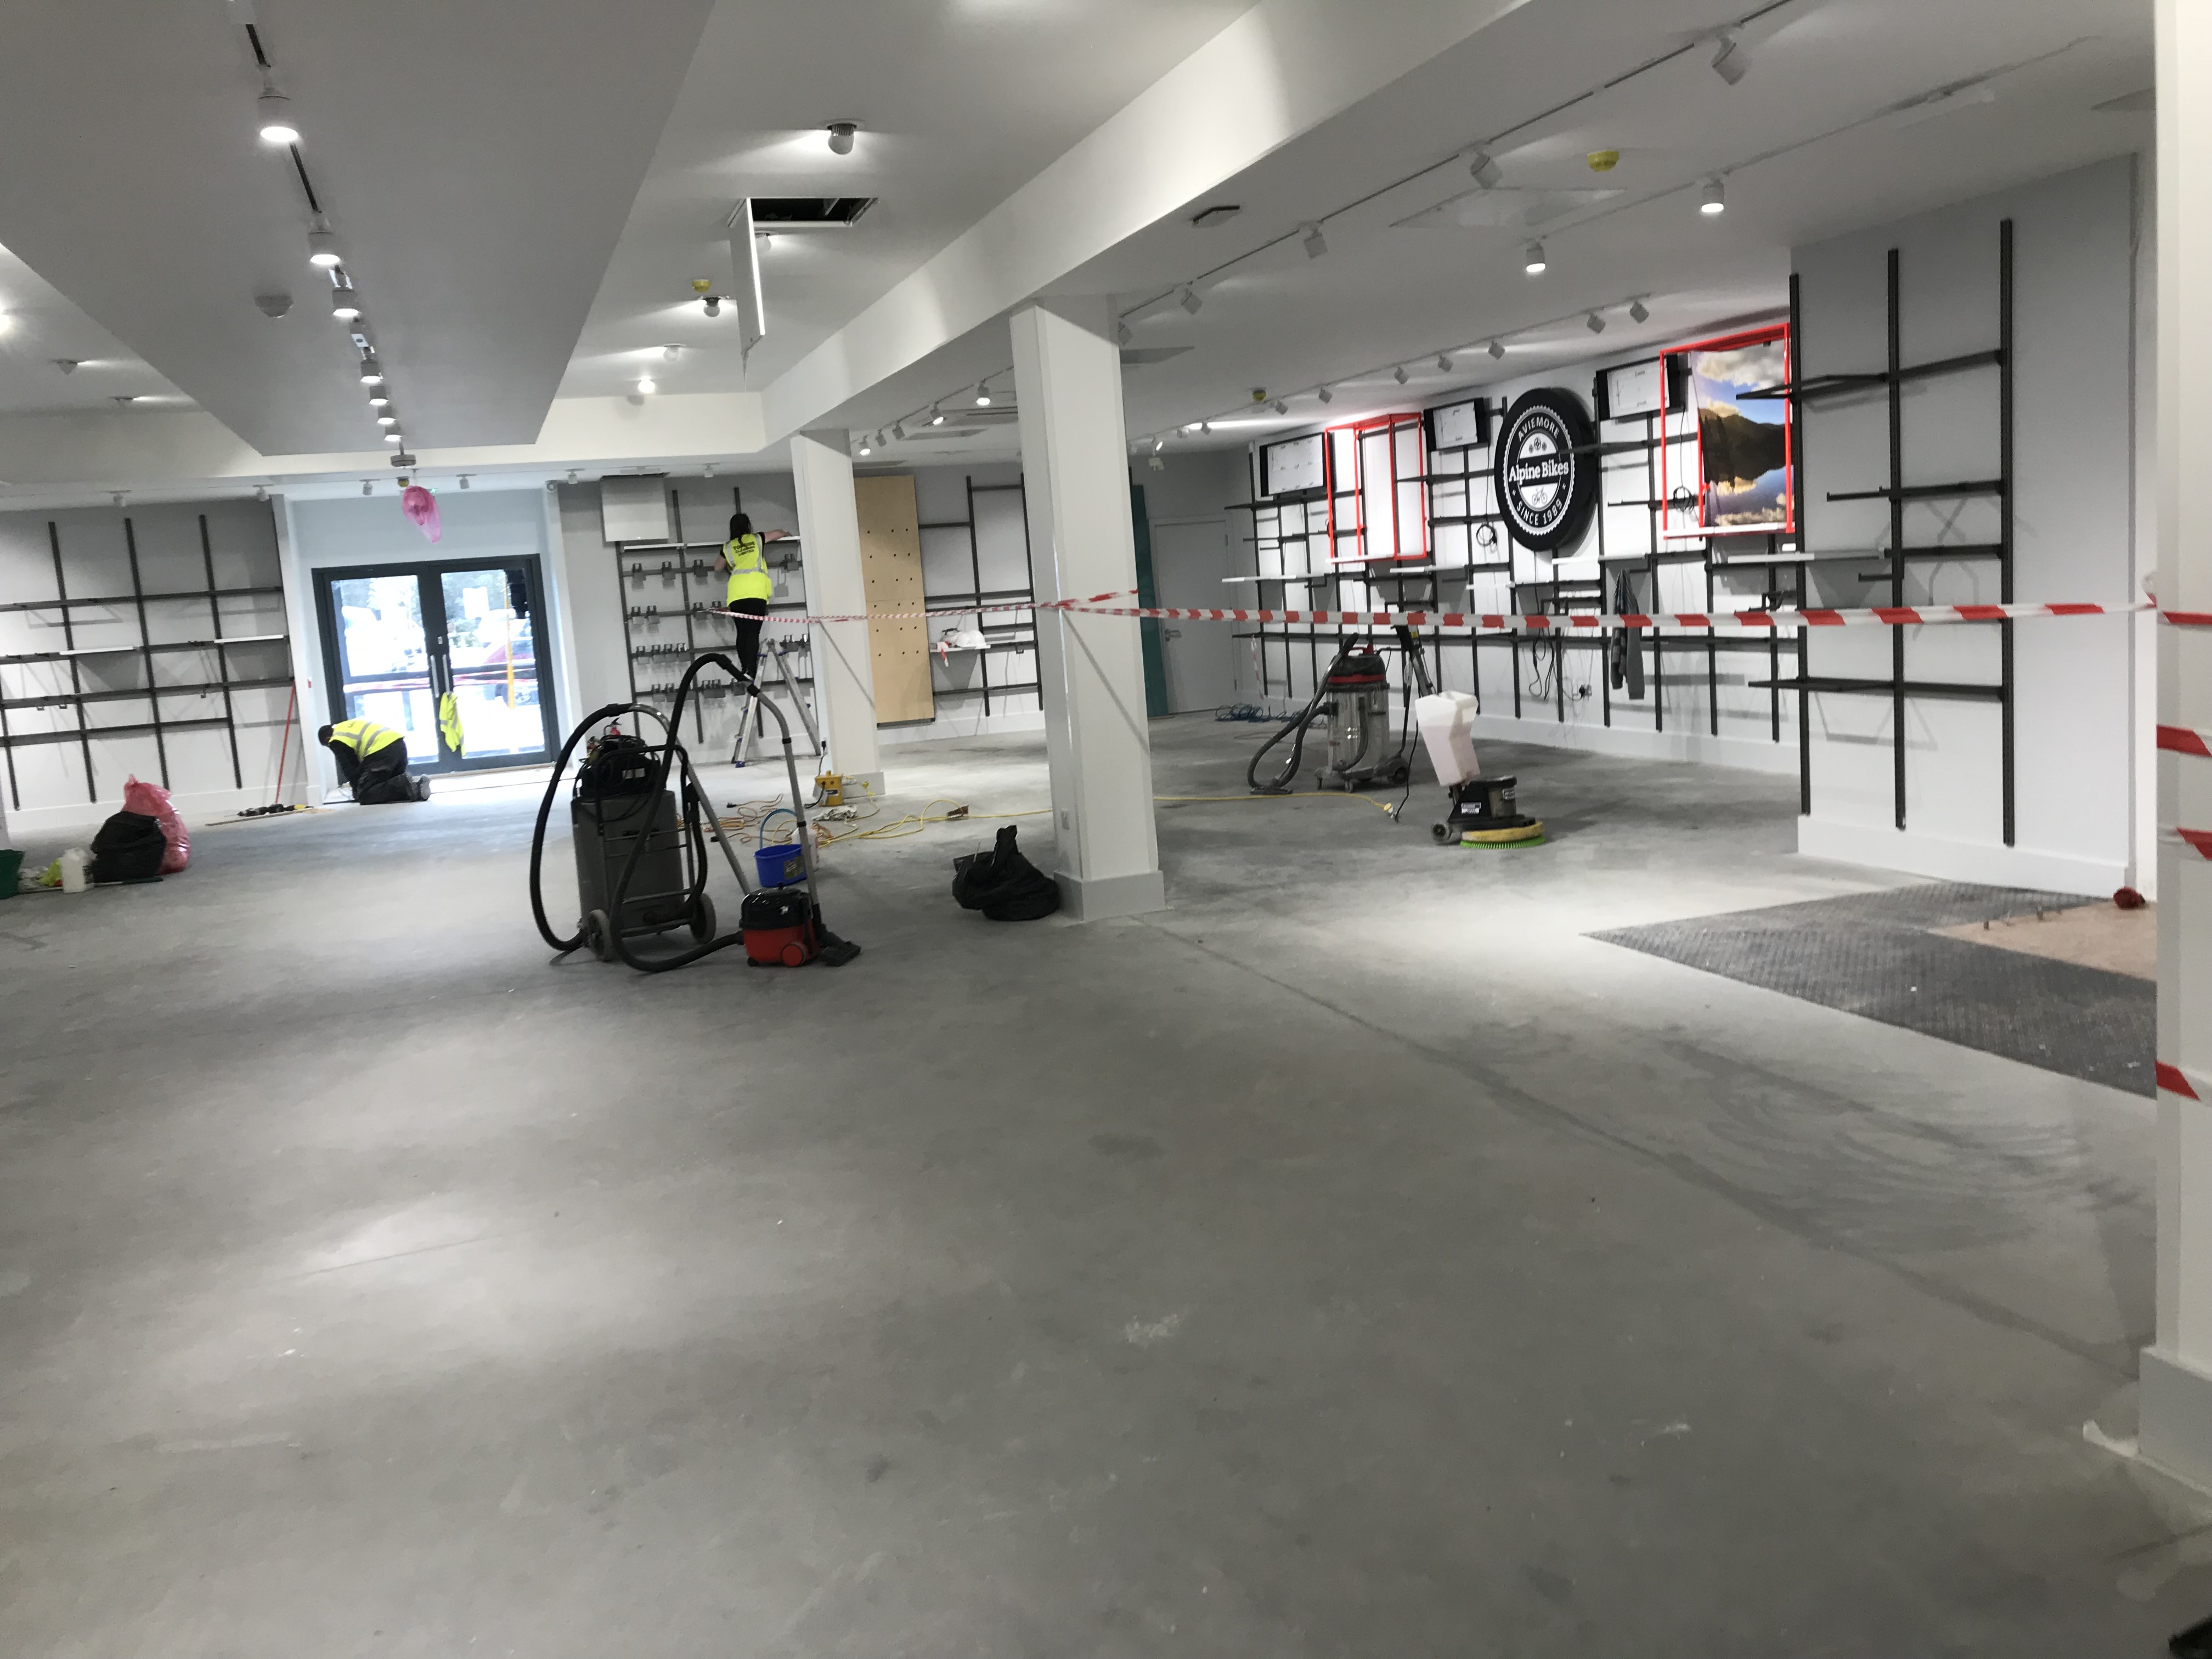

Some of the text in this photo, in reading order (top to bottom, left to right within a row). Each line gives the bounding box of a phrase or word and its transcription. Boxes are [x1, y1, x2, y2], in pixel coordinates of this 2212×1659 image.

[1517, 416, 1560, 442] AVIEMORE
[1509, 459, 1569, 486] Alpine Bikes
[1516, 497, 1562, 526] SINCE 1989
